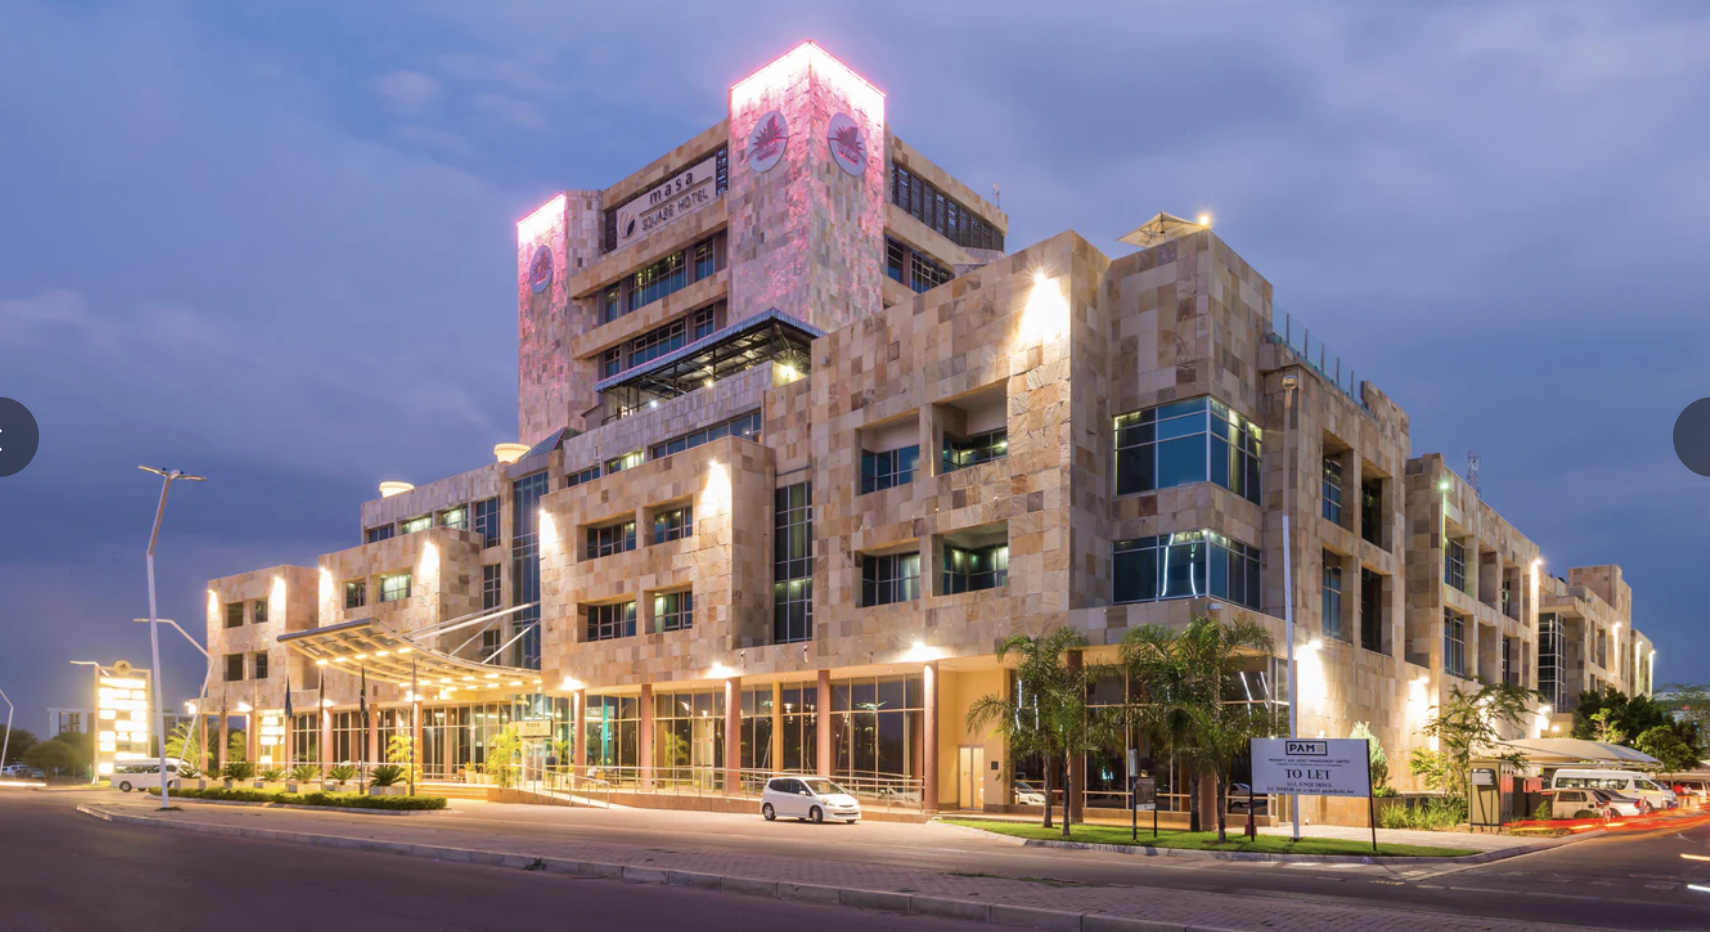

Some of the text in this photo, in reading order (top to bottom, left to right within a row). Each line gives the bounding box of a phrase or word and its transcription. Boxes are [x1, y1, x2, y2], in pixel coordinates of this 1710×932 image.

[650, 172, 693, 205] masa
[641, 187, 708, 231] SQUARE HOTEL
[1289, 744, 1315, 752] PAM
[1284, 768, 1331, 780] TO LET
